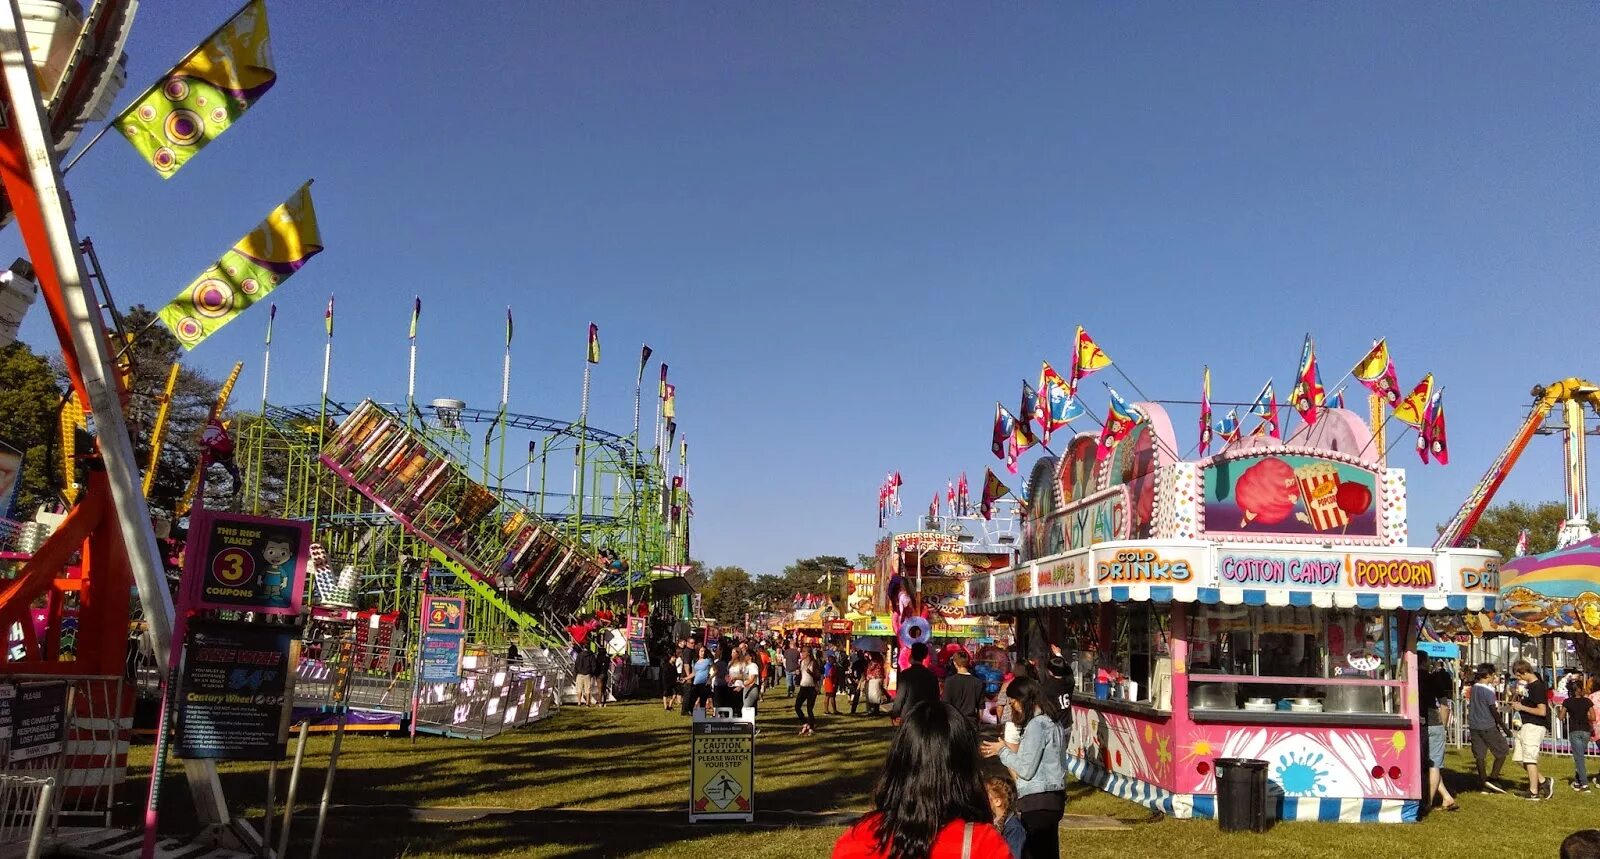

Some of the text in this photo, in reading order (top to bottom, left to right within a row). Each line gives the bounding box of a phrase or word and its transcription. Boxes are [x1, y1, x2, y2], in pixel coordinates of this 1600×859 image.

[216, 527, 261, 539] THIS RIDE
[223, 536, 253, 546] TAKES
[1117, 552, 1155, 563] COLD
[221, 553, 244, 580] 3
[1097, 562, 1190, 582] DRINKS
[1222, 557, 1341, 586] COTTON CANDY
[1357, 562, 1434, 586] POPCORN
[206, 587, 253, 598] COUPONS
[434, 610, 442, 620] 4
[187, 693, 254, 704] Century Wheel
[1059, 693, 1071, 709] 16
[22, 714, 57, 726] WE CANNOT BE
[17, 722, 59, 736] RESPONSIBLE FOR
[20, 731, 56, 744] LOST ARTICLES
[25, 747, 41, 755] THANK
